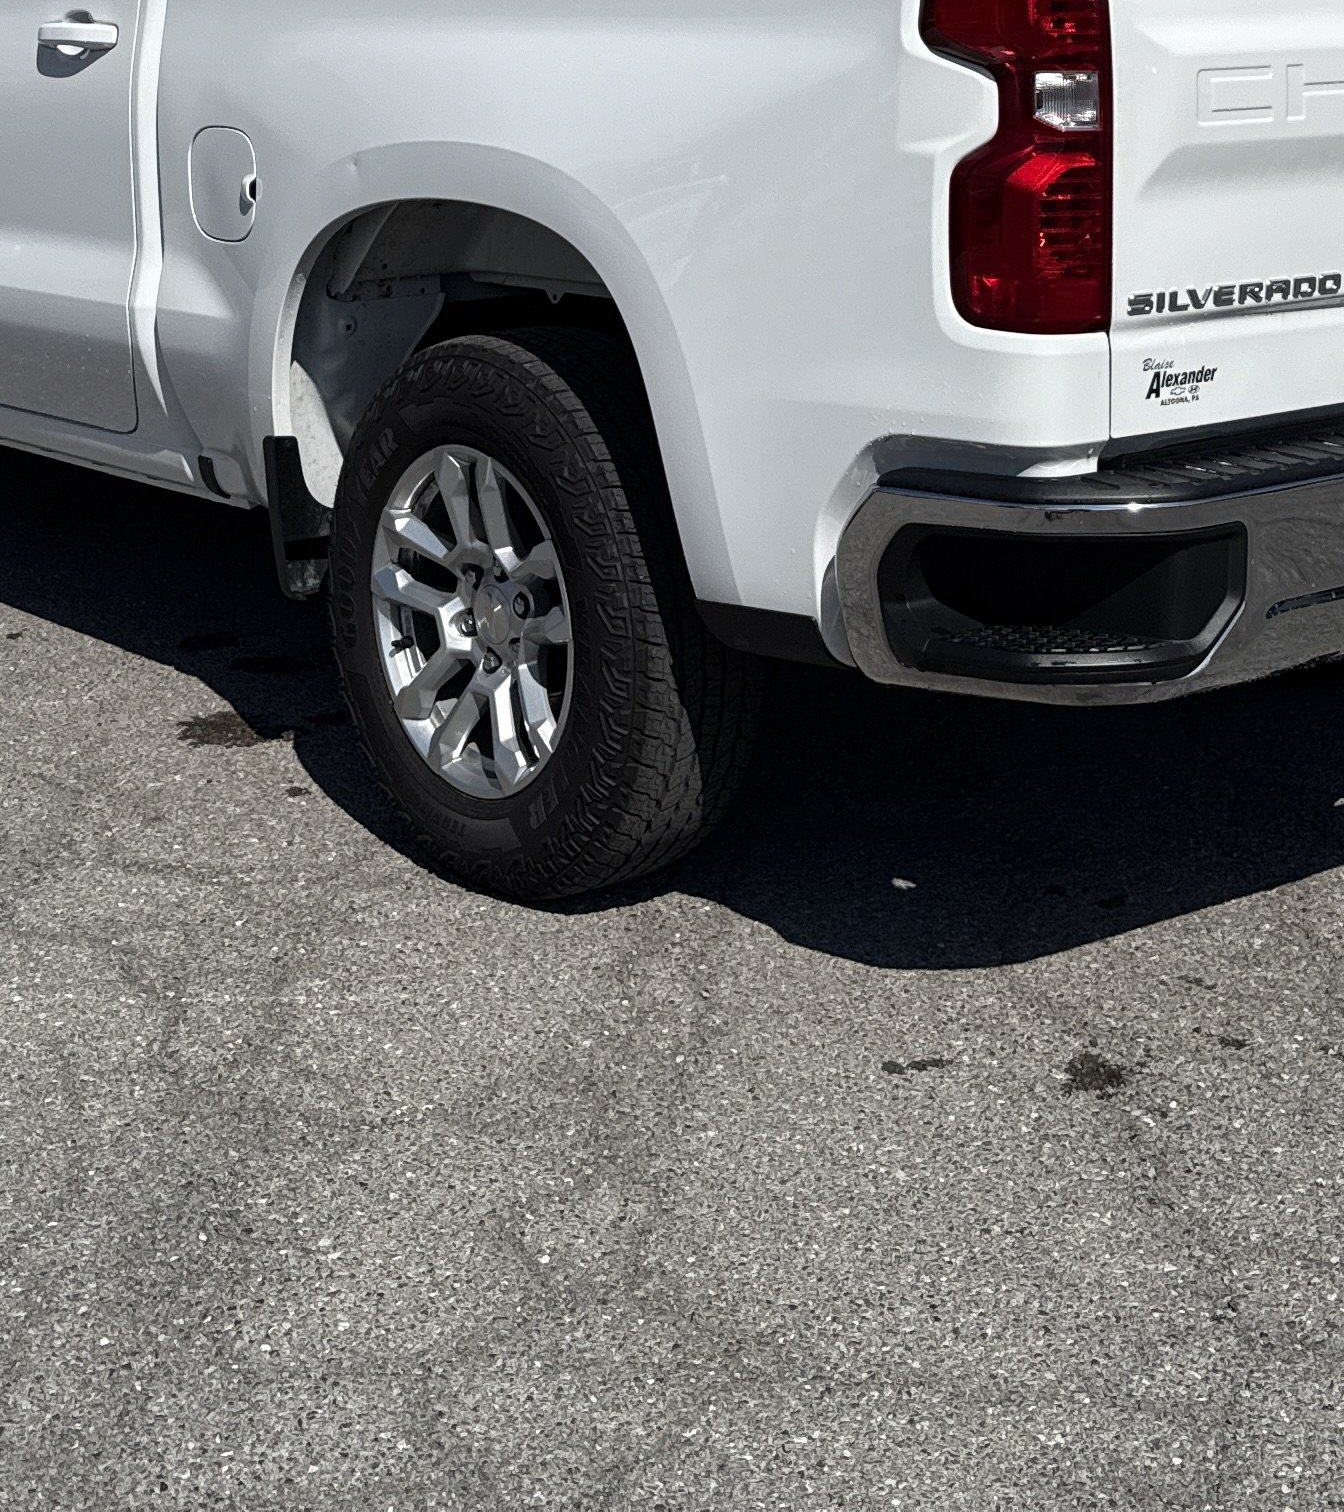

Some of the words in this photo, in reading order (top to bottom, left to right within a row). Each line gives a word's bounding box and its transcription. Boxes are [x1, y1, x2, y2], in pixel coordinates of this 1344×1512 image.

[1126, 271, 1342, 317] SILVERADO
[1141, 357, 1175, 372] Blaise
[1145, 364, 1218, 400] Alexander
